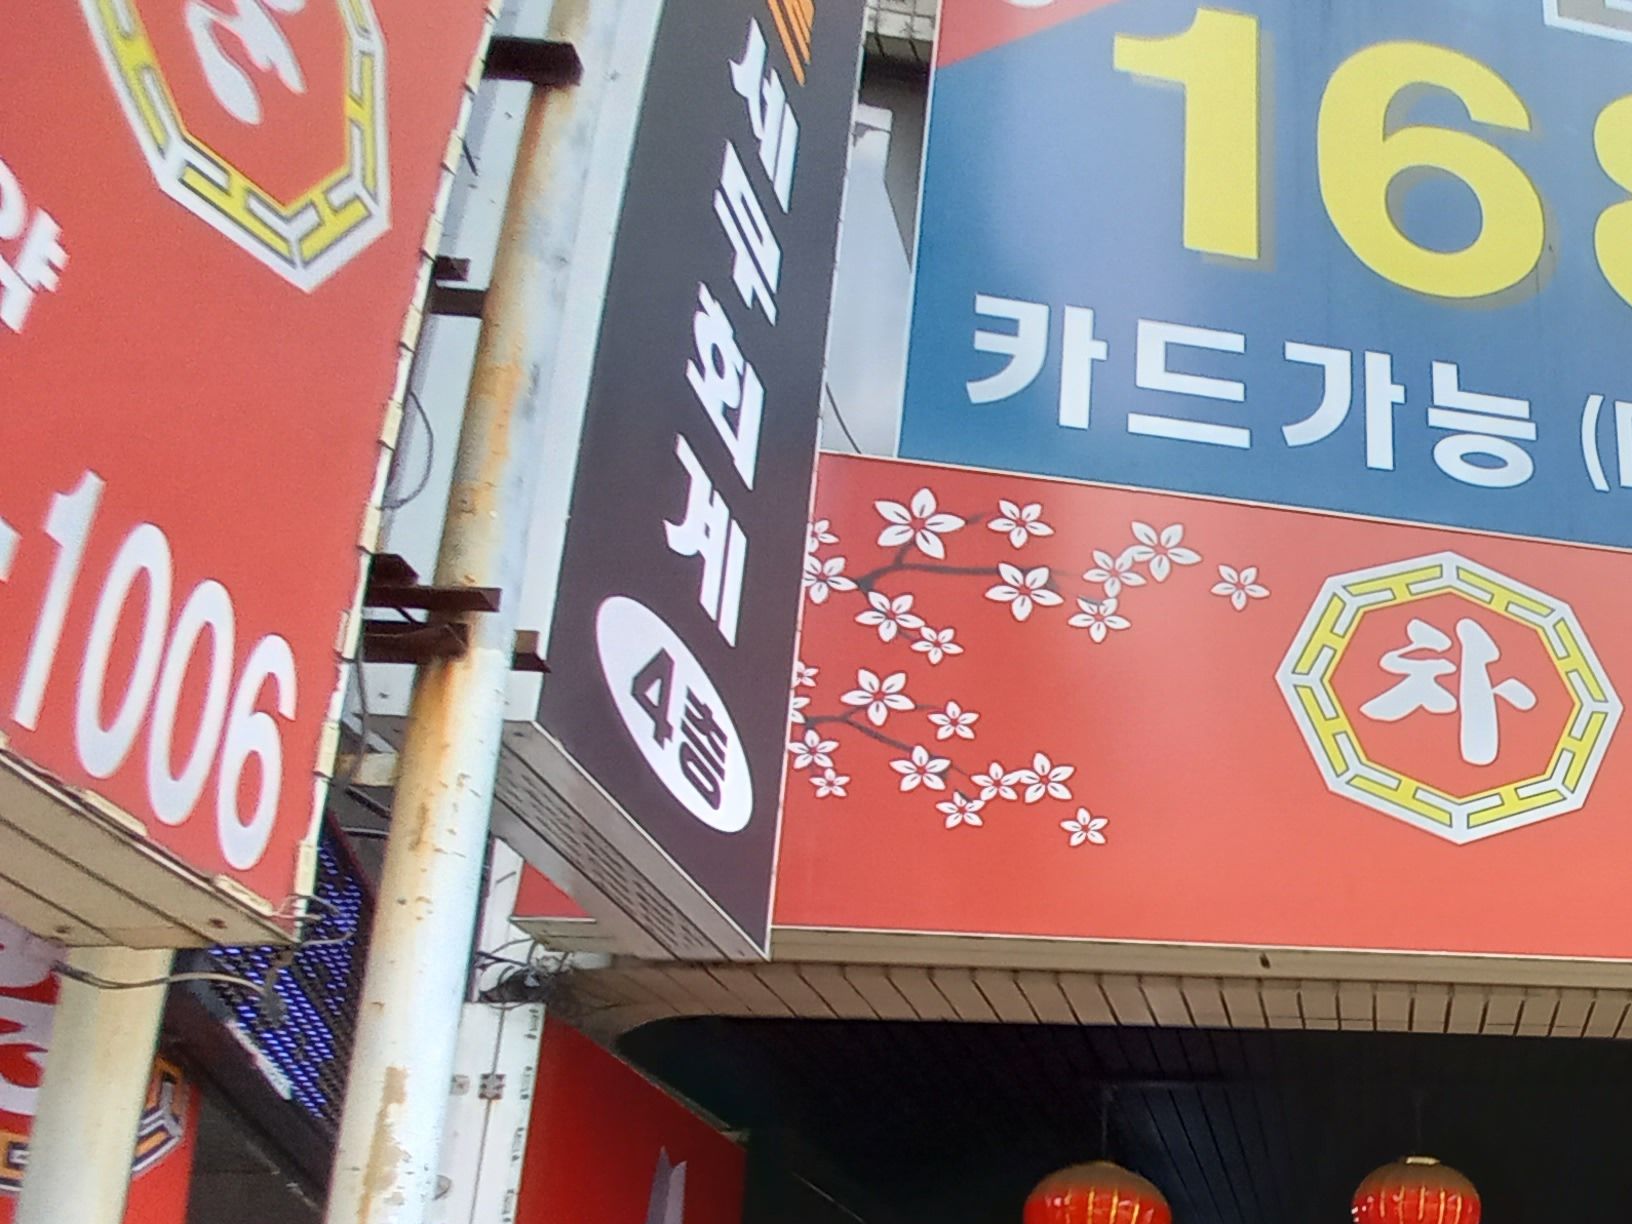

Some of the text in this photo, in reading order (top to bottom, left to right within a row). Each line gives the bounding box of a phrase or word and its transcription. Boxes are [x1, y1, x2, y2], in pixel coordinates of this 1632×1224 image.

[664, 17, 799, 648] 세무회계
[966, 294, 1537, 488] 카드가능
[631, 647, 729, 813] 4층
